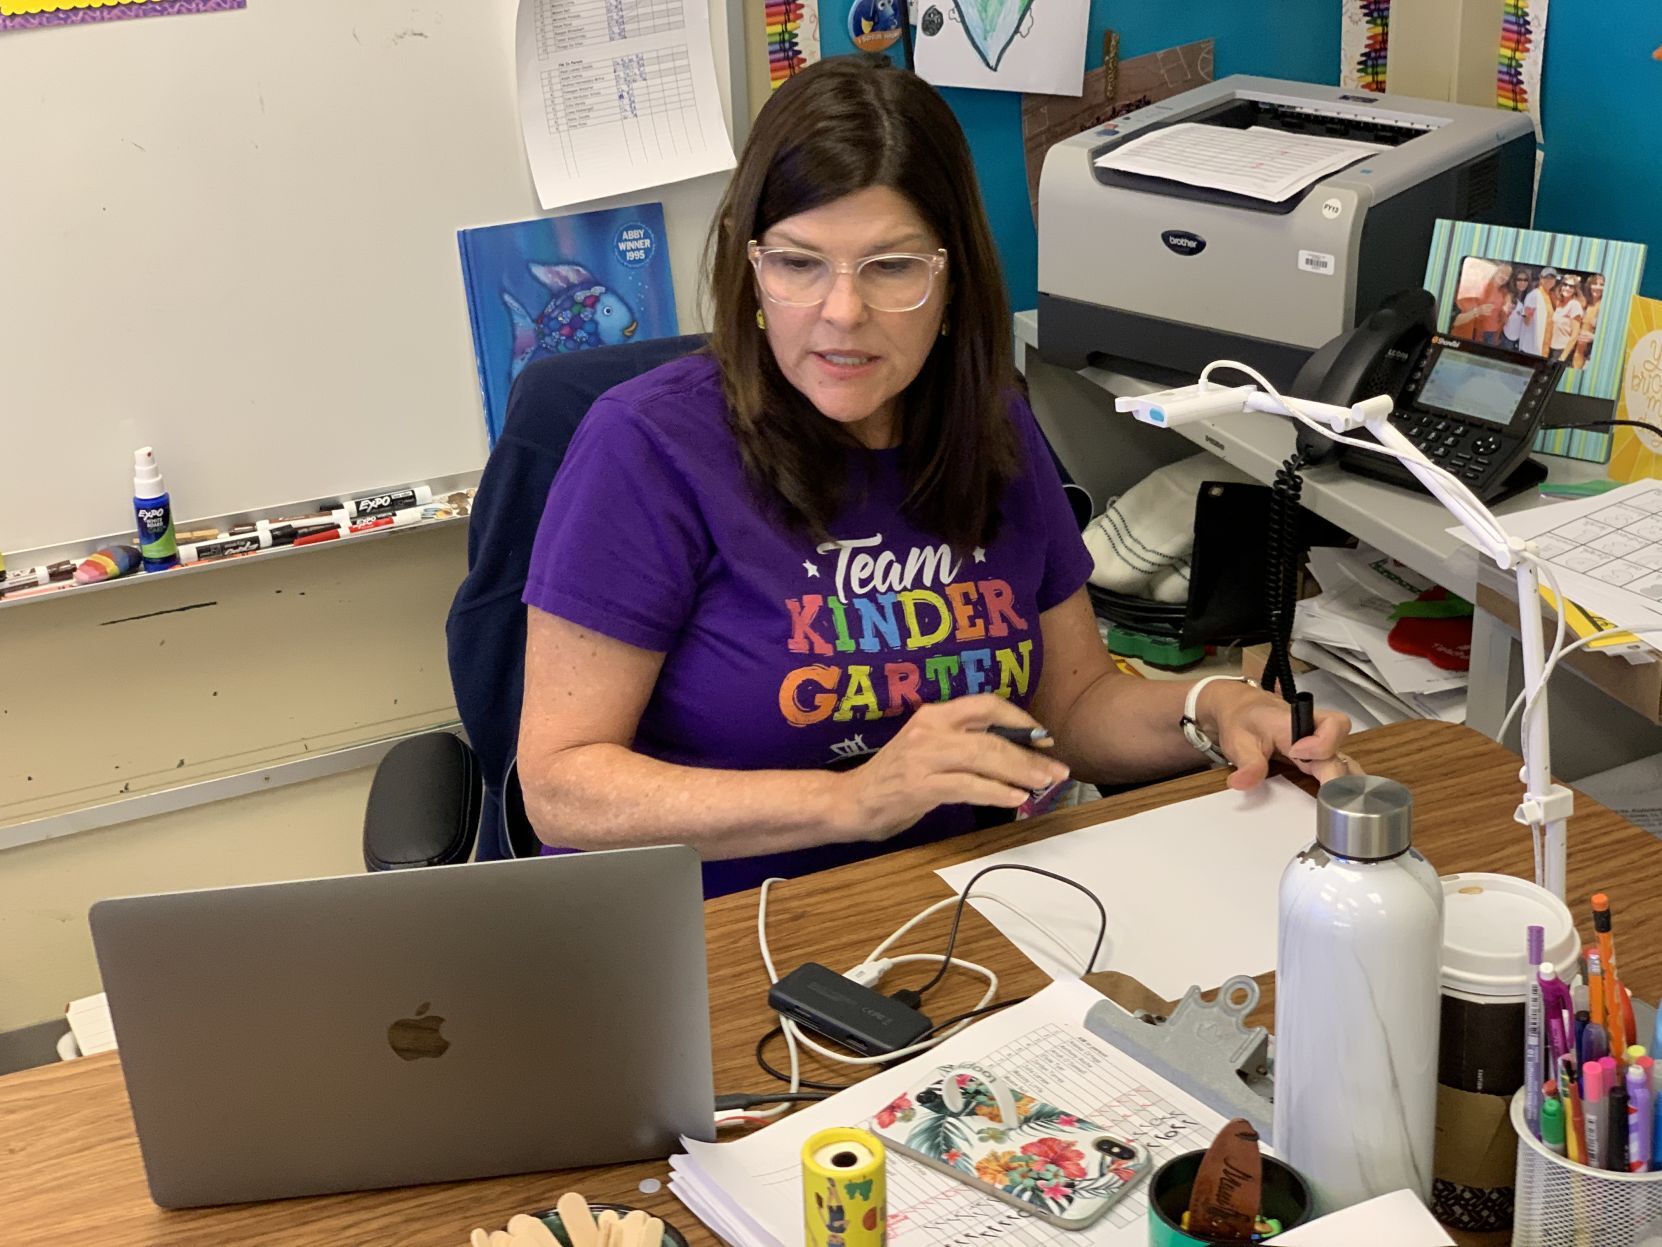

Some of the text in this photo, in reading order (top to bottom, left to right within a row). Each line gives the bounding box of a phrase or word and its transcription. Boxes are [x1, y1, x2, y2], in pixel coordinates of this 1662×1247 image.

[1323, 203, 1340, 214] FY13
[622, 229, 645, 241] ABBY
[618, 239, 651, 251] WINNER
[1169, 235, 1198, 249] brother
[626, 250, 646, 261] 1995
[358, 496, 391, 513] EXPO
[138, 508, 164, 521] EXPO
[816, 532, 964, 604] Team
[784, 577, 1029, 657] KINDER
[778, 639, 1034, 728] GARTEN
